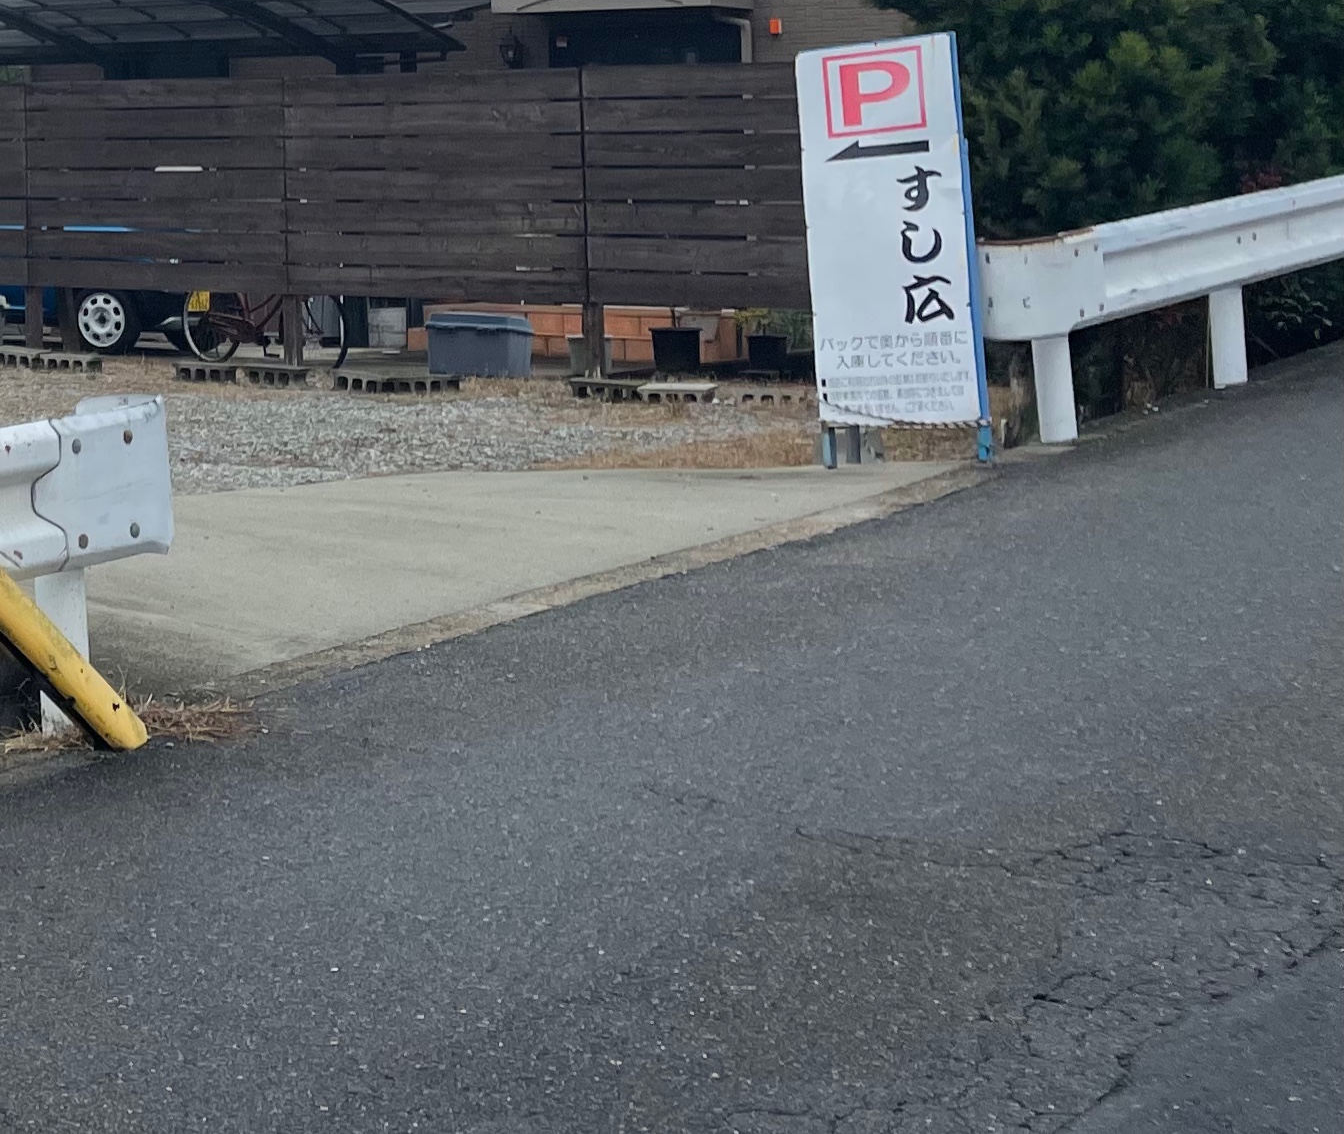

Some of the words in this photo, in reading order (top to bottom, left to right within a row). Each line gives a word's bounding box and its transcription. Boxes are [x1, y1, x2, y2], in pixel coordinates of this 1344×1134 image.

[838, 60, 912, 127] P
[895, 165, 956, 325] すし広
